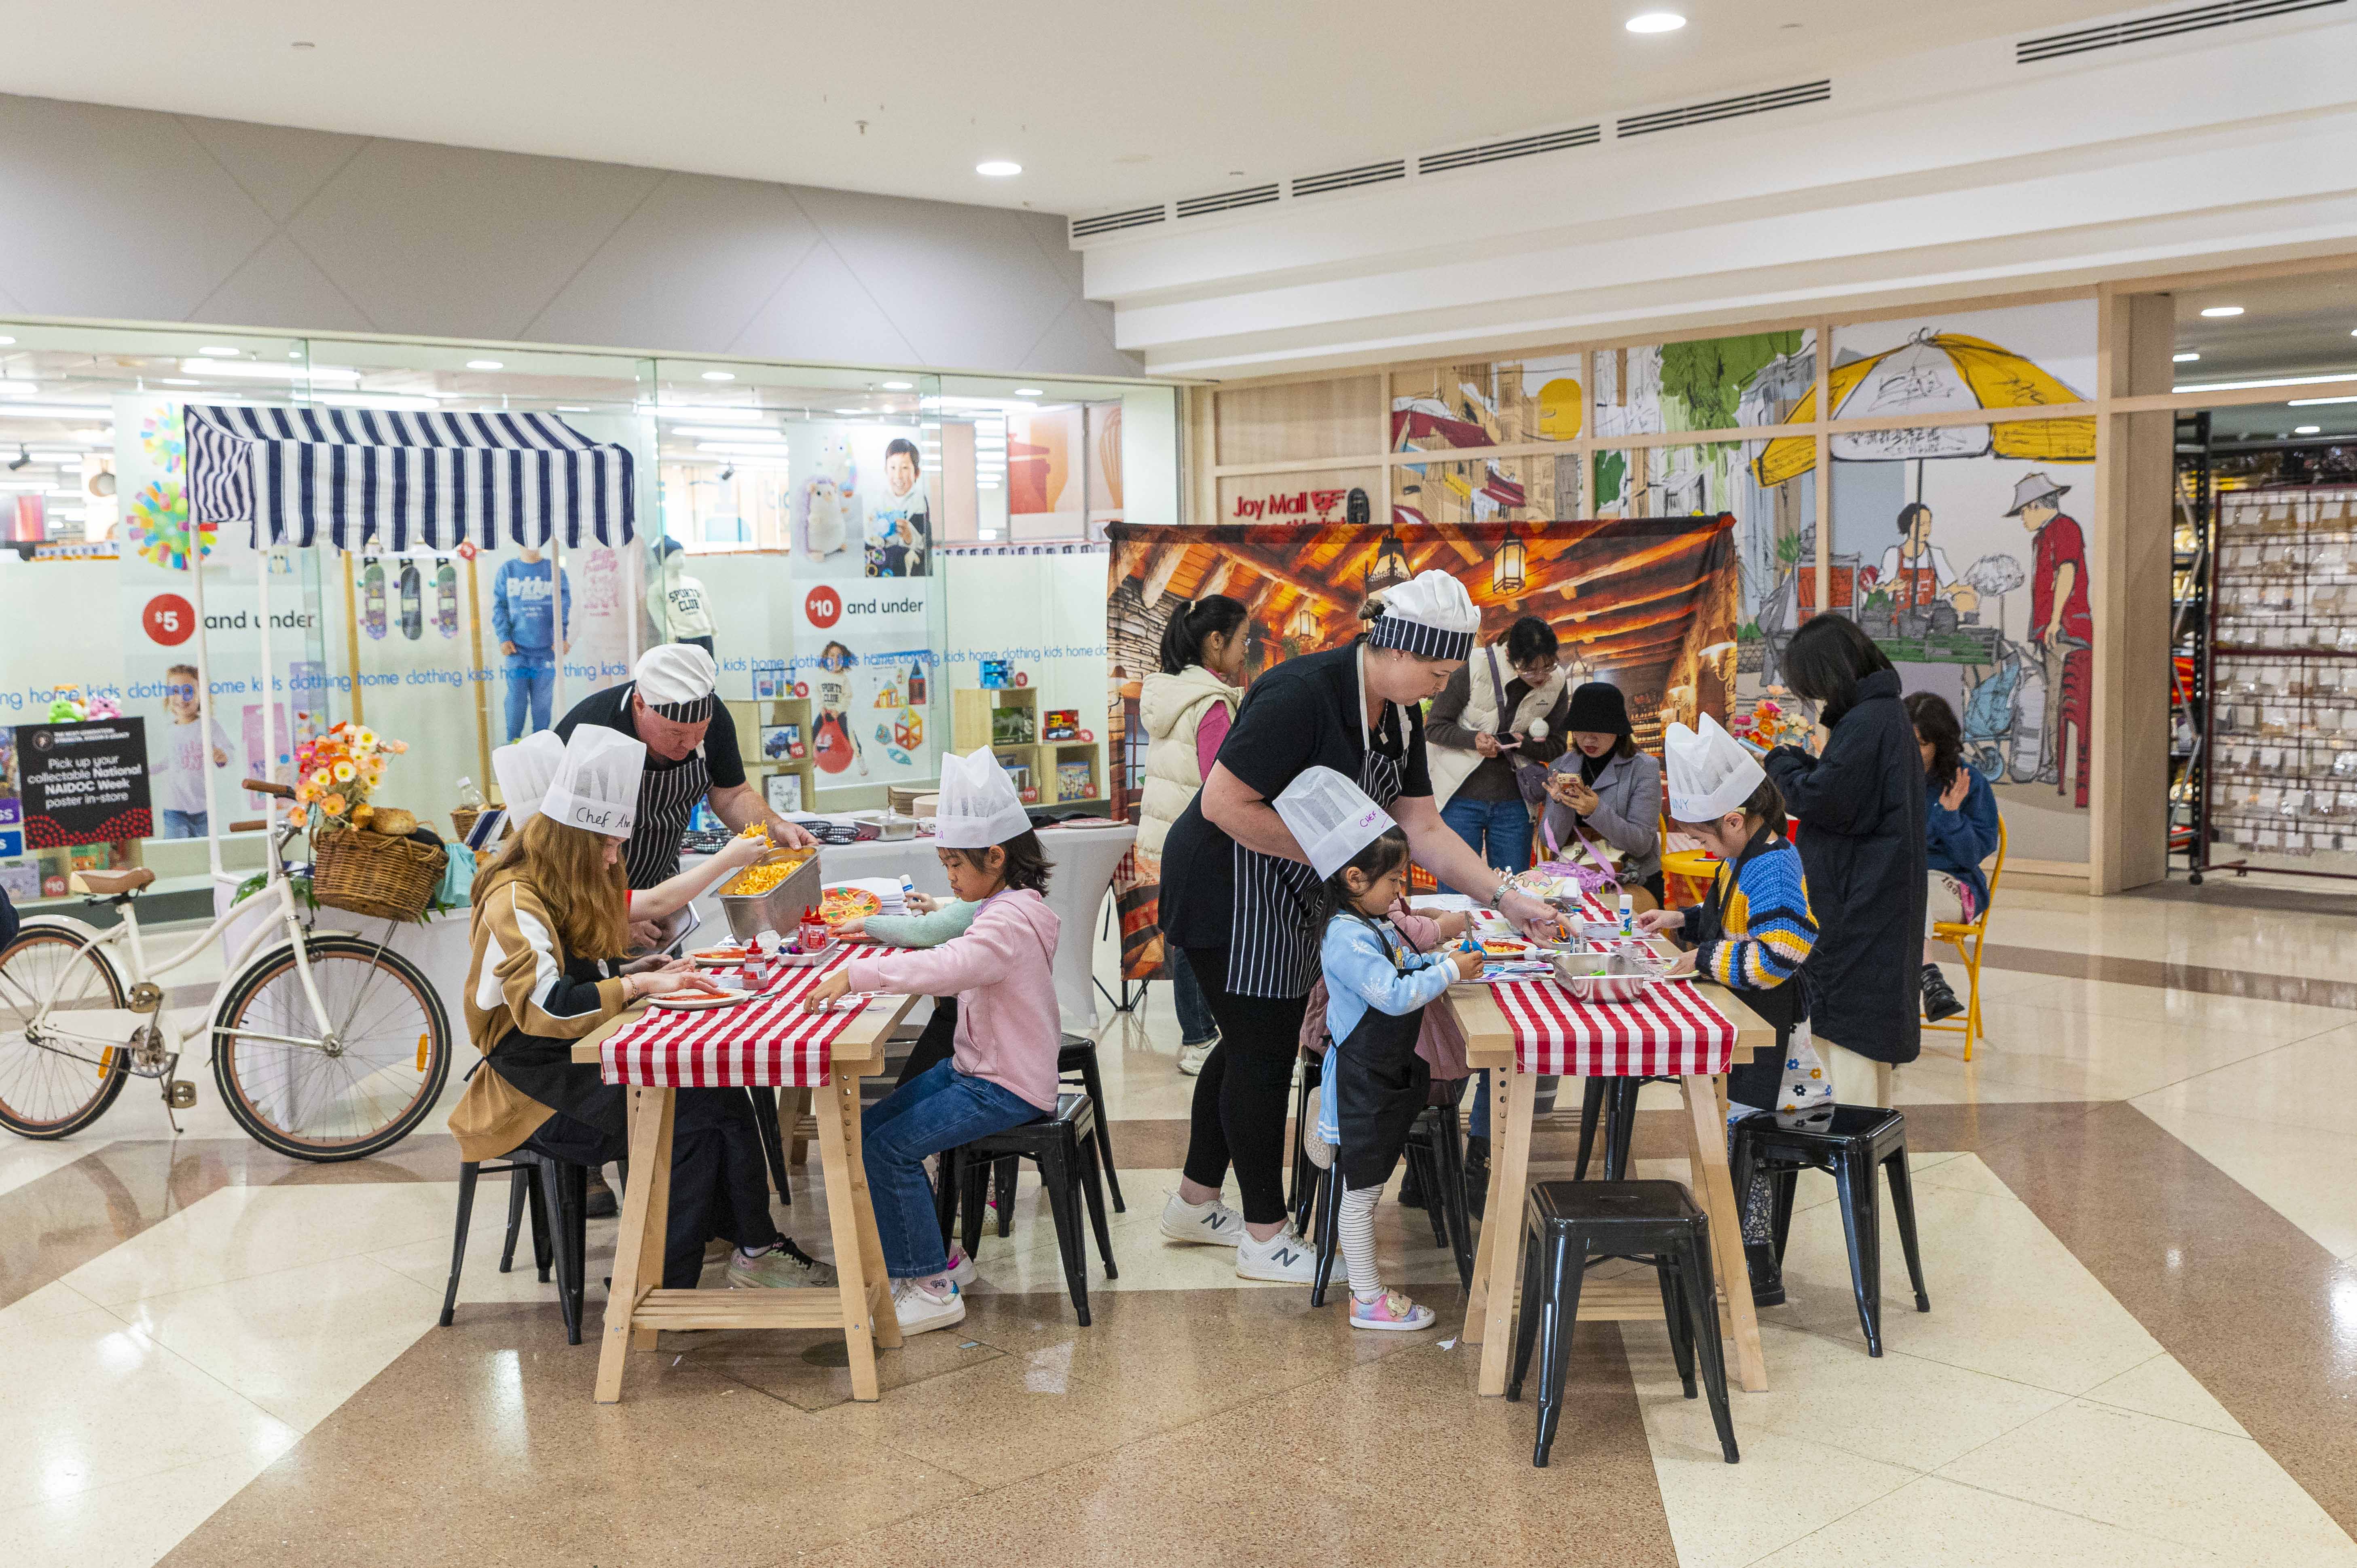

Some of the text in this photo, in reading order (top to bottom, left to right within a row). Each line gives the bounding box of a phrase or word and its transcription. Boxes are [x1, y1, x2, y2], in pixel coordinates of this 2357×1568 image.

[1234, 492, 1307, 520] Joy Mall
[810, 597, 923, 617] $10 and under
[154, 611, 179, 632] $5
[204, 610, 246, 629] and
[127, 680, 193, 702] clothing
[209, 680, 245, 695] ome
[251, 675, 283, 691] kis
[289, 673, 351, 693] clothing
[356, 671, 399, 685] home
[405, 668, 463, 687] clothing
[467, 667, 495, 681] kids
[563, 662, 597, 682] thing
[601, 660, 627, 676] kids
[724, 657, 747, 671] kids
[751, 654, 785, 670] home
[944, 648, 965, 662] kids
[969, 648, 998, 661] home
[1002, 647, 1041, 662] clothing
[1044, 645, 1062, 657] kids
[1066, 645, 1092, 657] home
[1095, 644, 1107, 655] clo
[48, 755, 120, 769] Pick up your
[27, 763, 142, 784] collectable National
[44, 777, 130, 796] NAIDOC Week
[45, 792, 129, 811] poster in-store
[576, 807, 611, 828] Chef
[1360, 810, 1376, 827] CHEF
[1271, 1247, 1300, 1267] N
